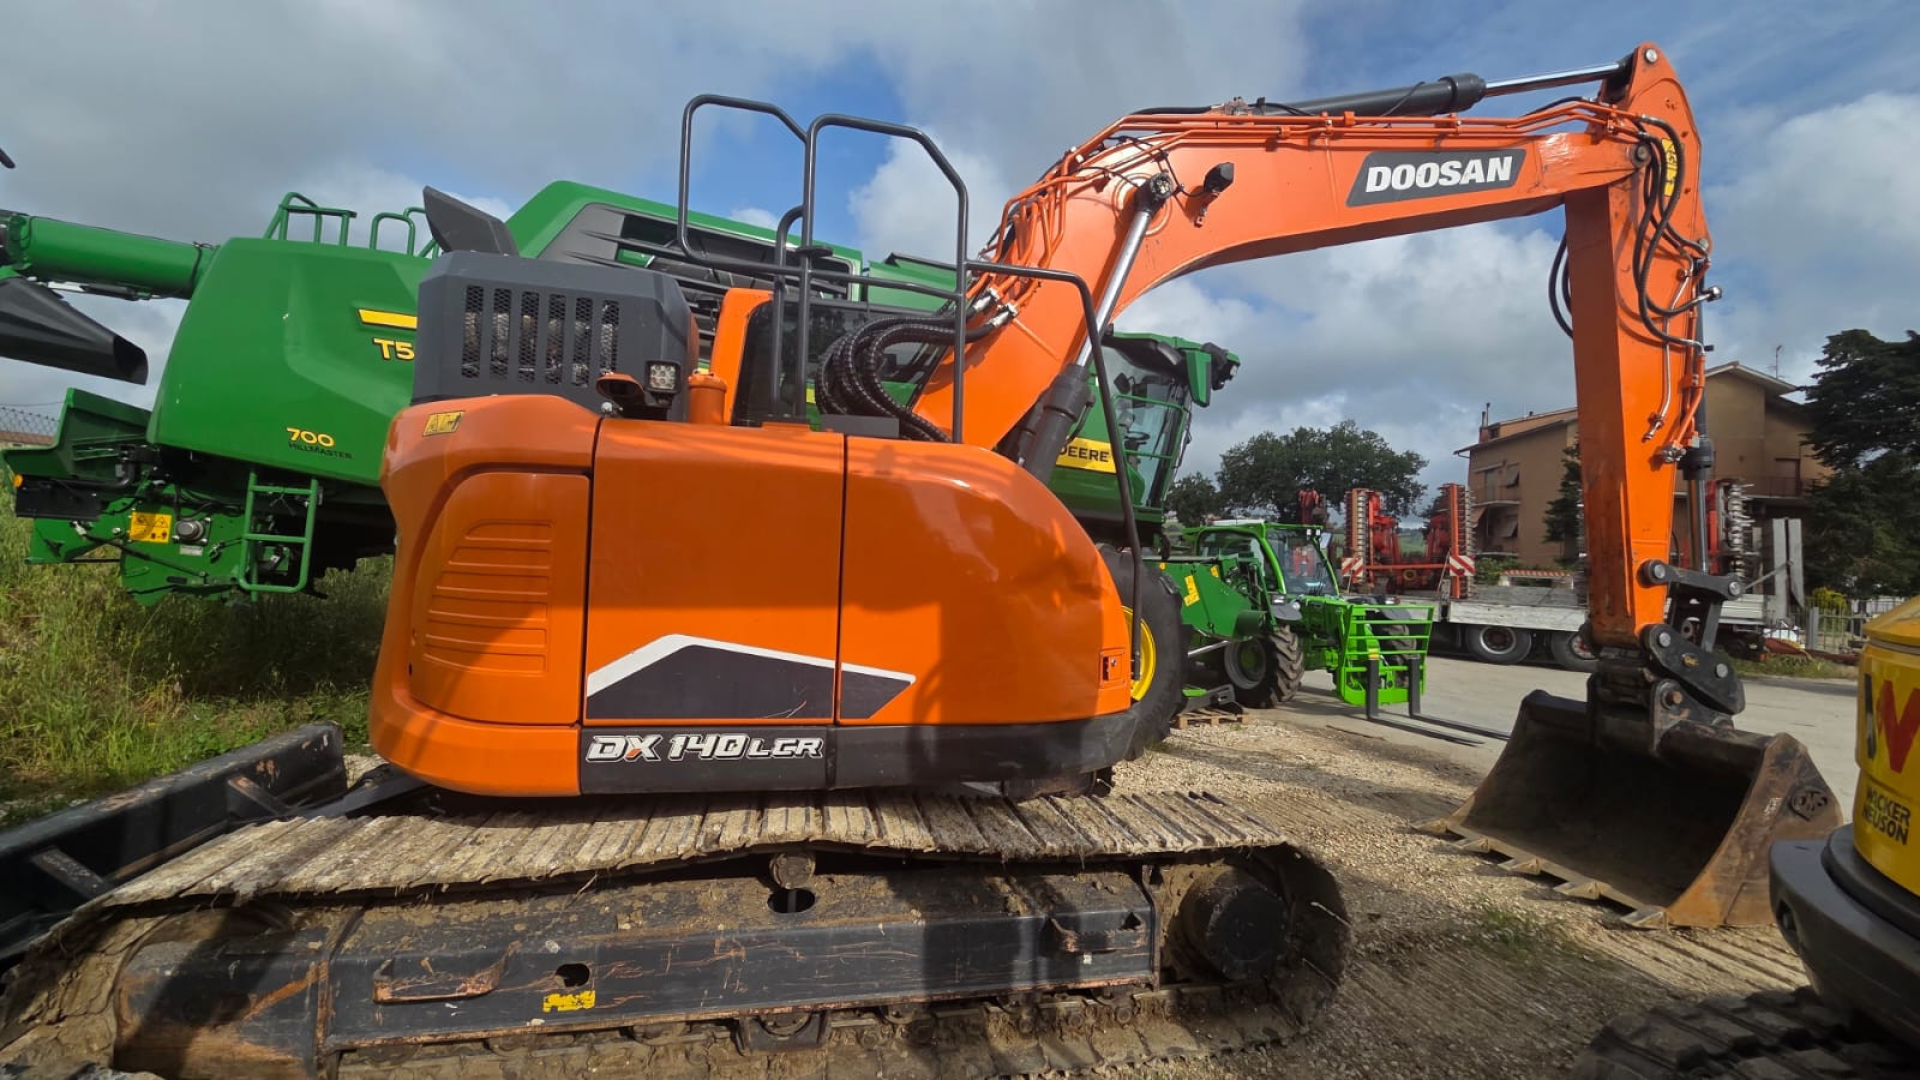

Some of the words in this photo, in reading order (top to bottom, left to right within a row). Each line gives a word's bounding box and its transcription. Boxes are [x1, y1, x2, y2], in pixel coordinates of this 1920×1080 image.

[1365, 156, 1513, 193] DOOSAN
[286, 427, 335, 448] 700
[586, 735, 663, 762] DX
